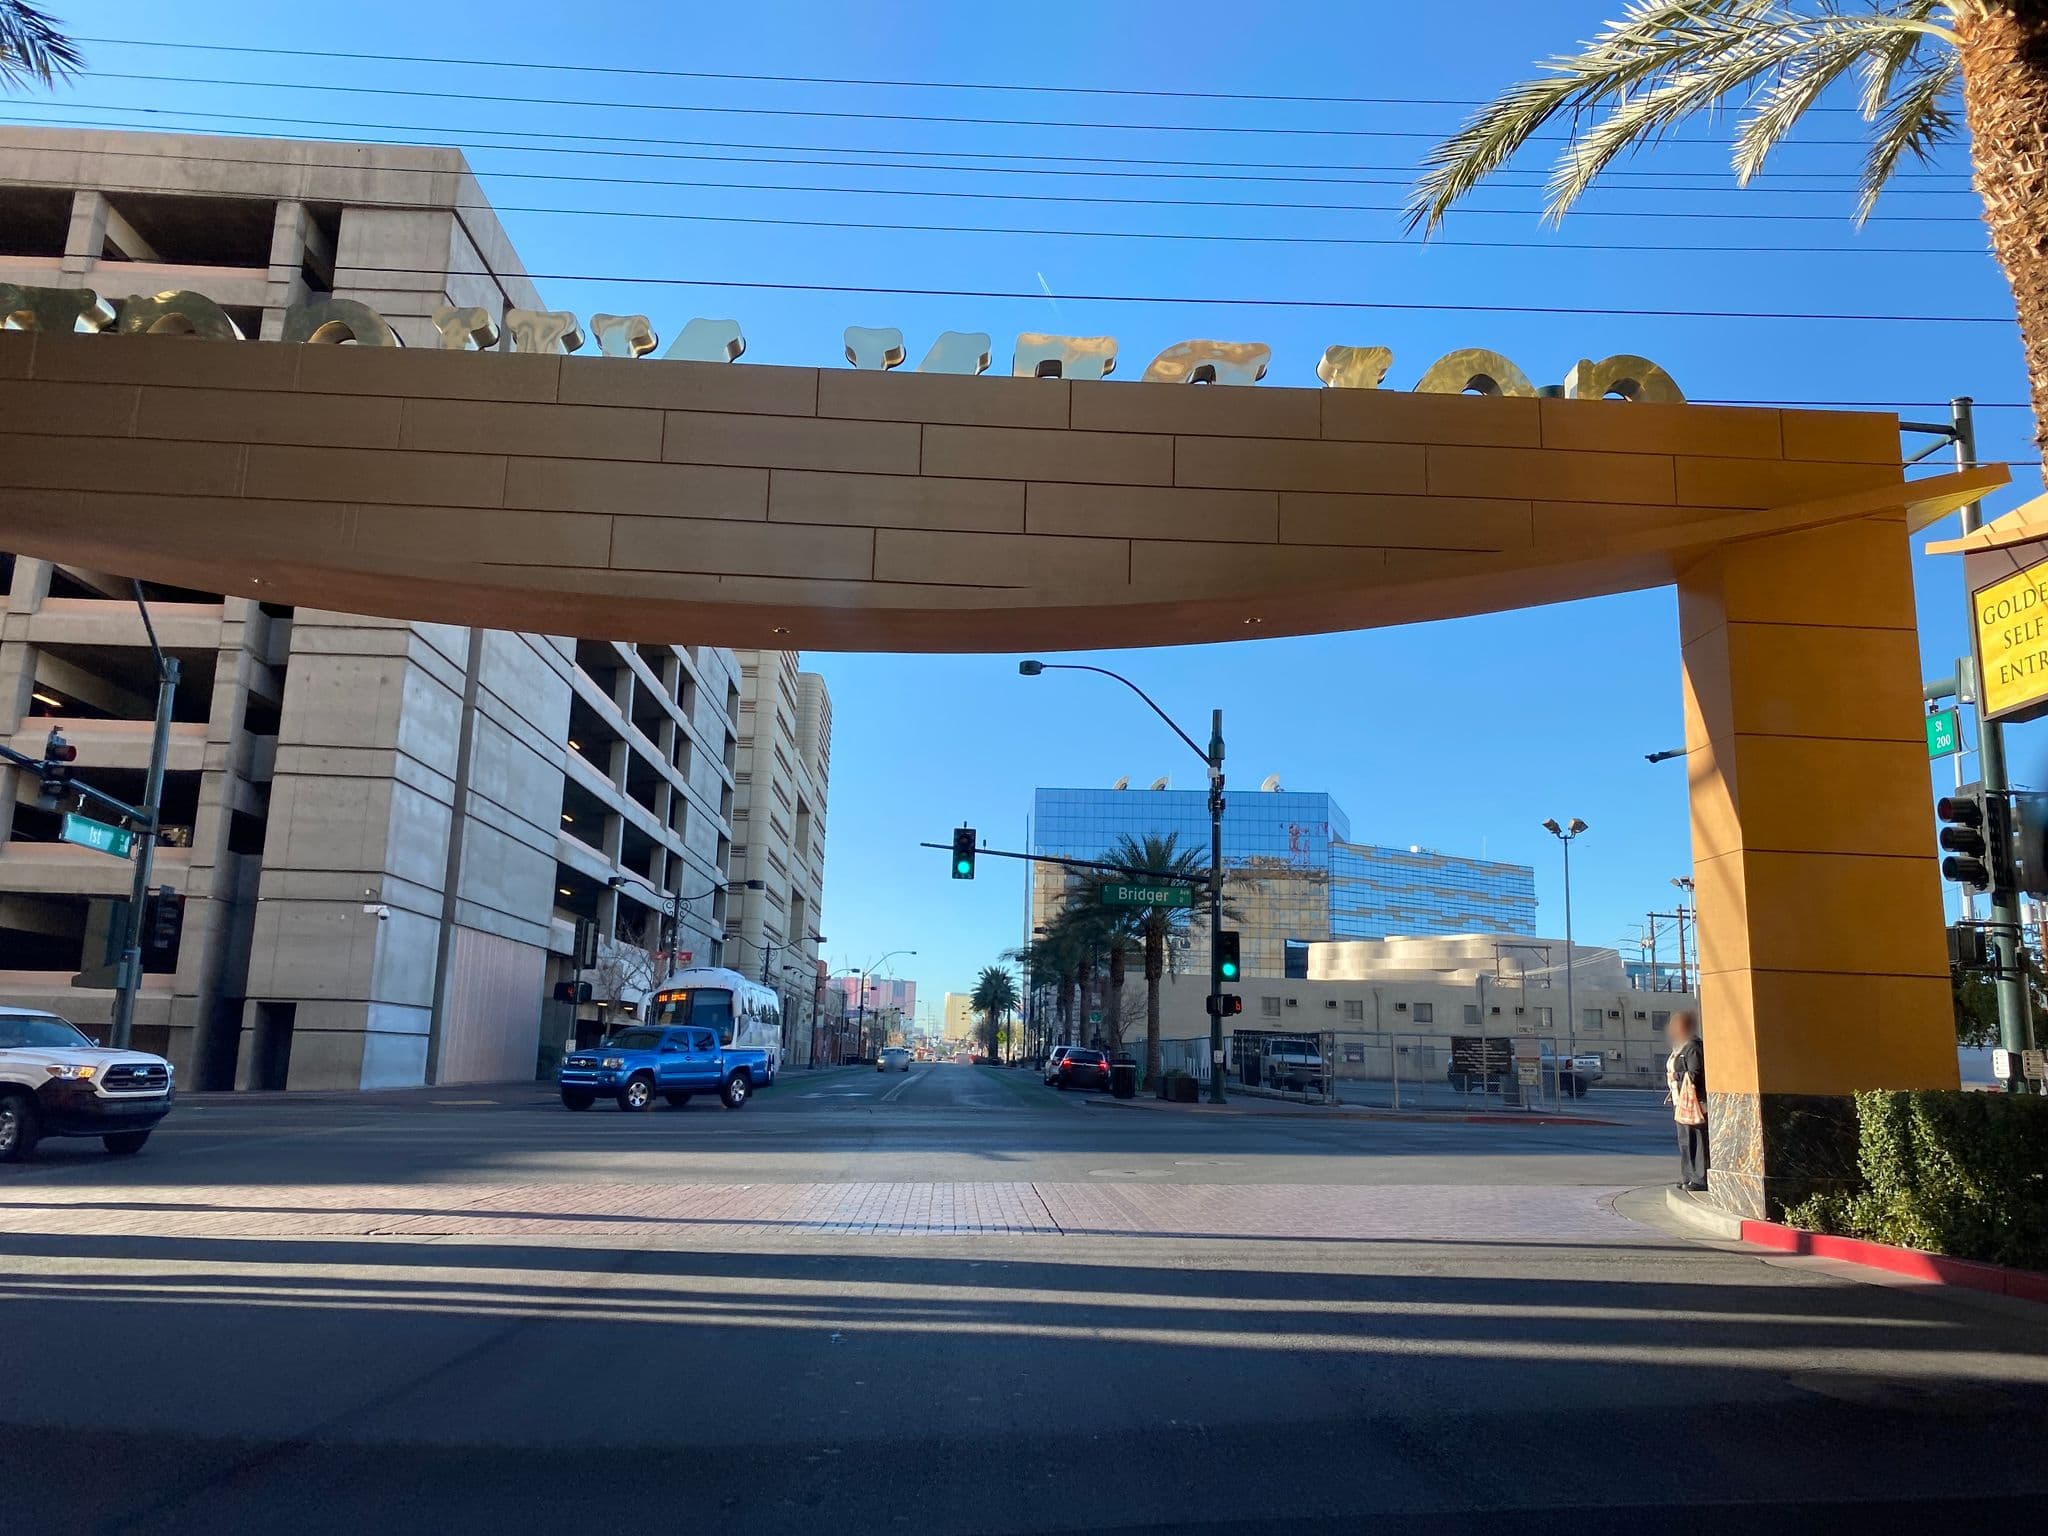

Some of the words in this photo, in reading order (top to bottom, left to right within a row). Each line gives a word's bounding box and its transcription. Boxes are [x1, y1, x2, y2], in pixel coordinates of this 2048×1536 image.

[1983, 582, 2048, 625] GOLDE
[2003, 616, 2044, 650] SELF
[1936, 733, 1951, 749] 200
[1118, 887, 1169, 904] Bridger
